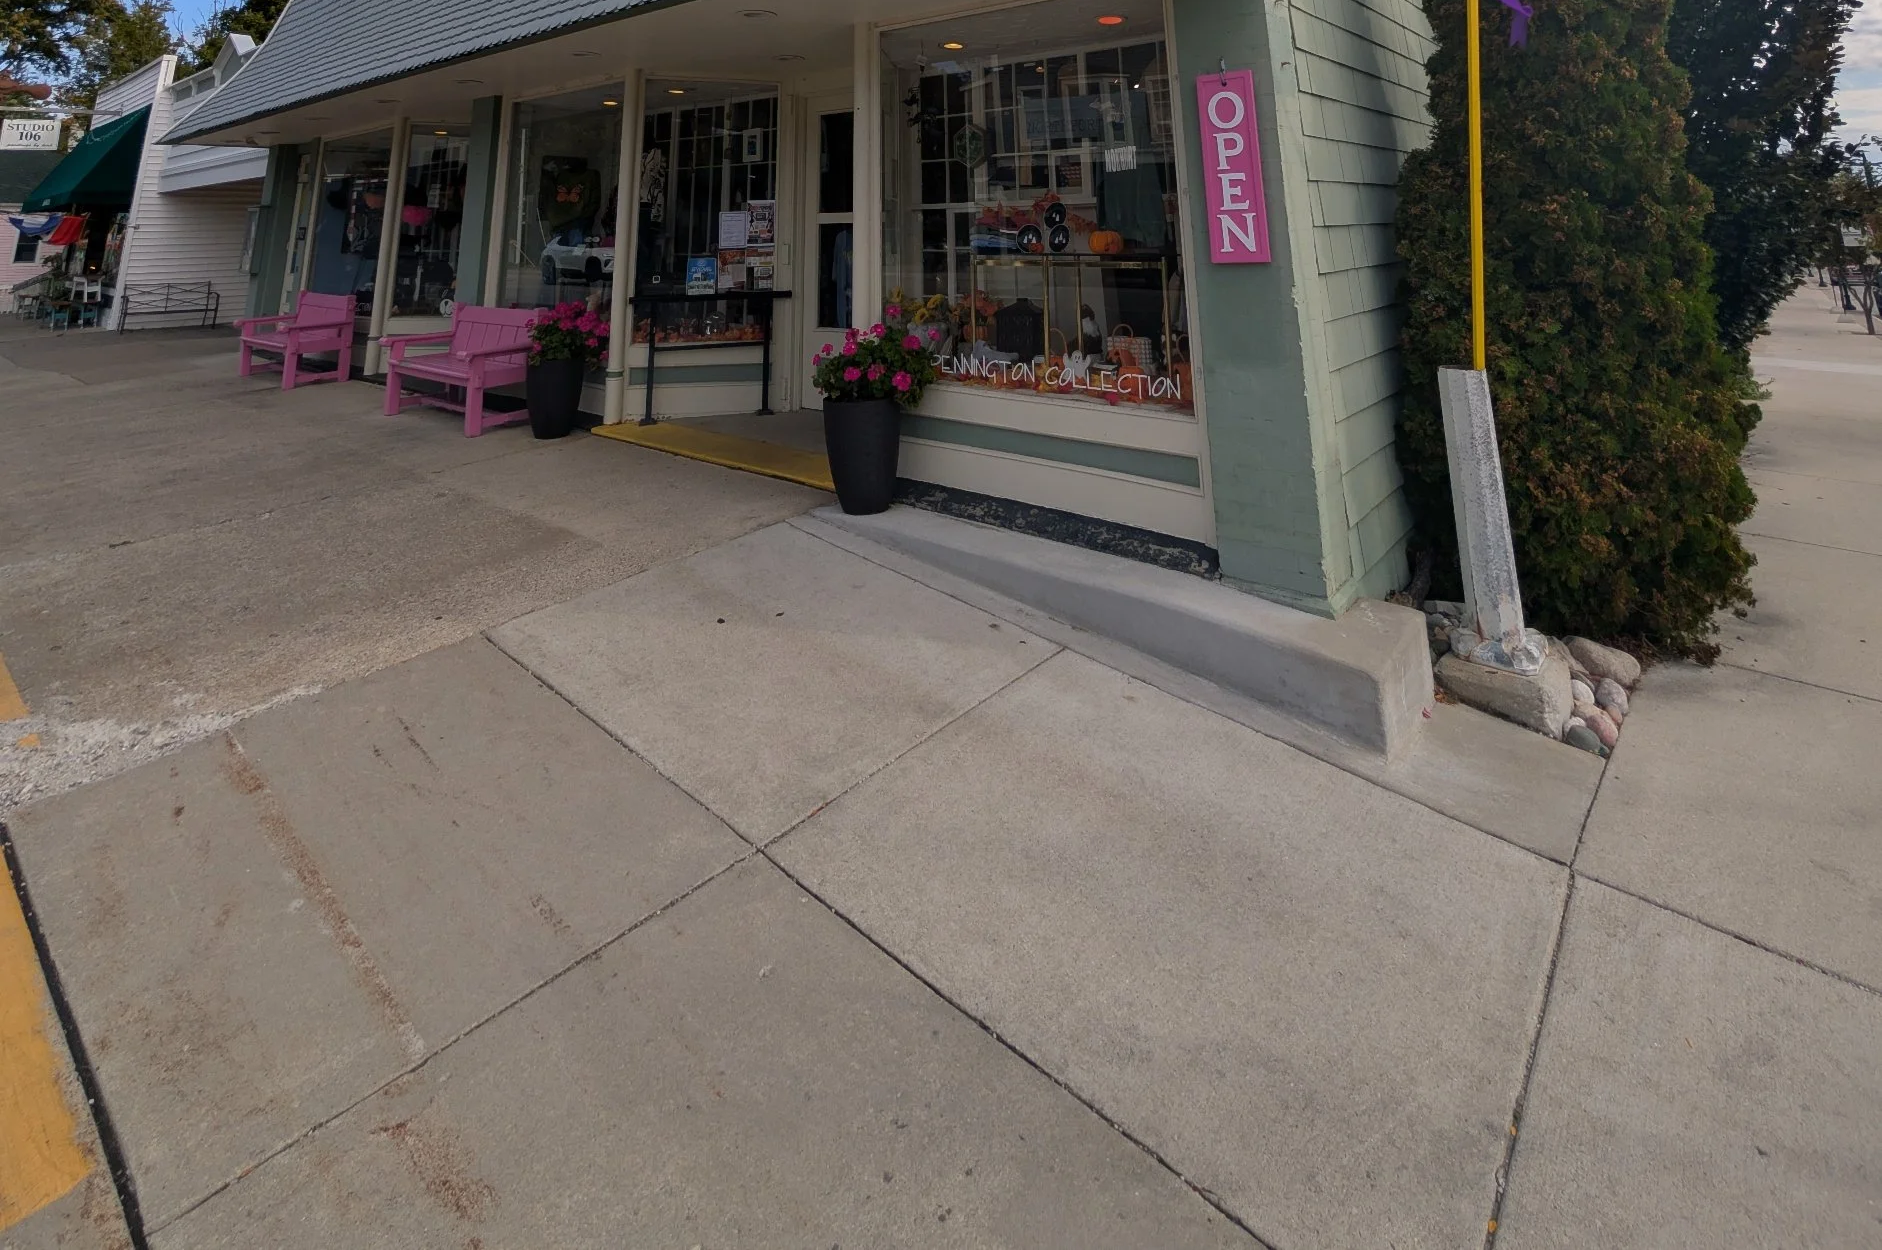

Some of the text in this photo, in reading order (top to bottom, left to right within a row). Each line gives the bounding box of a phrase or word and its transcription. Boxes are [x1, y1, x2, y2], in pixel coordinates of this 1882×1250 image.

[6, 123, 55, 132] STUDIO
[19, 131, 41, 141] 106
[1208, 92, 1257, 253] OPEN
[930, 353, 1181, 400] PENNINGTON COLLECTION
